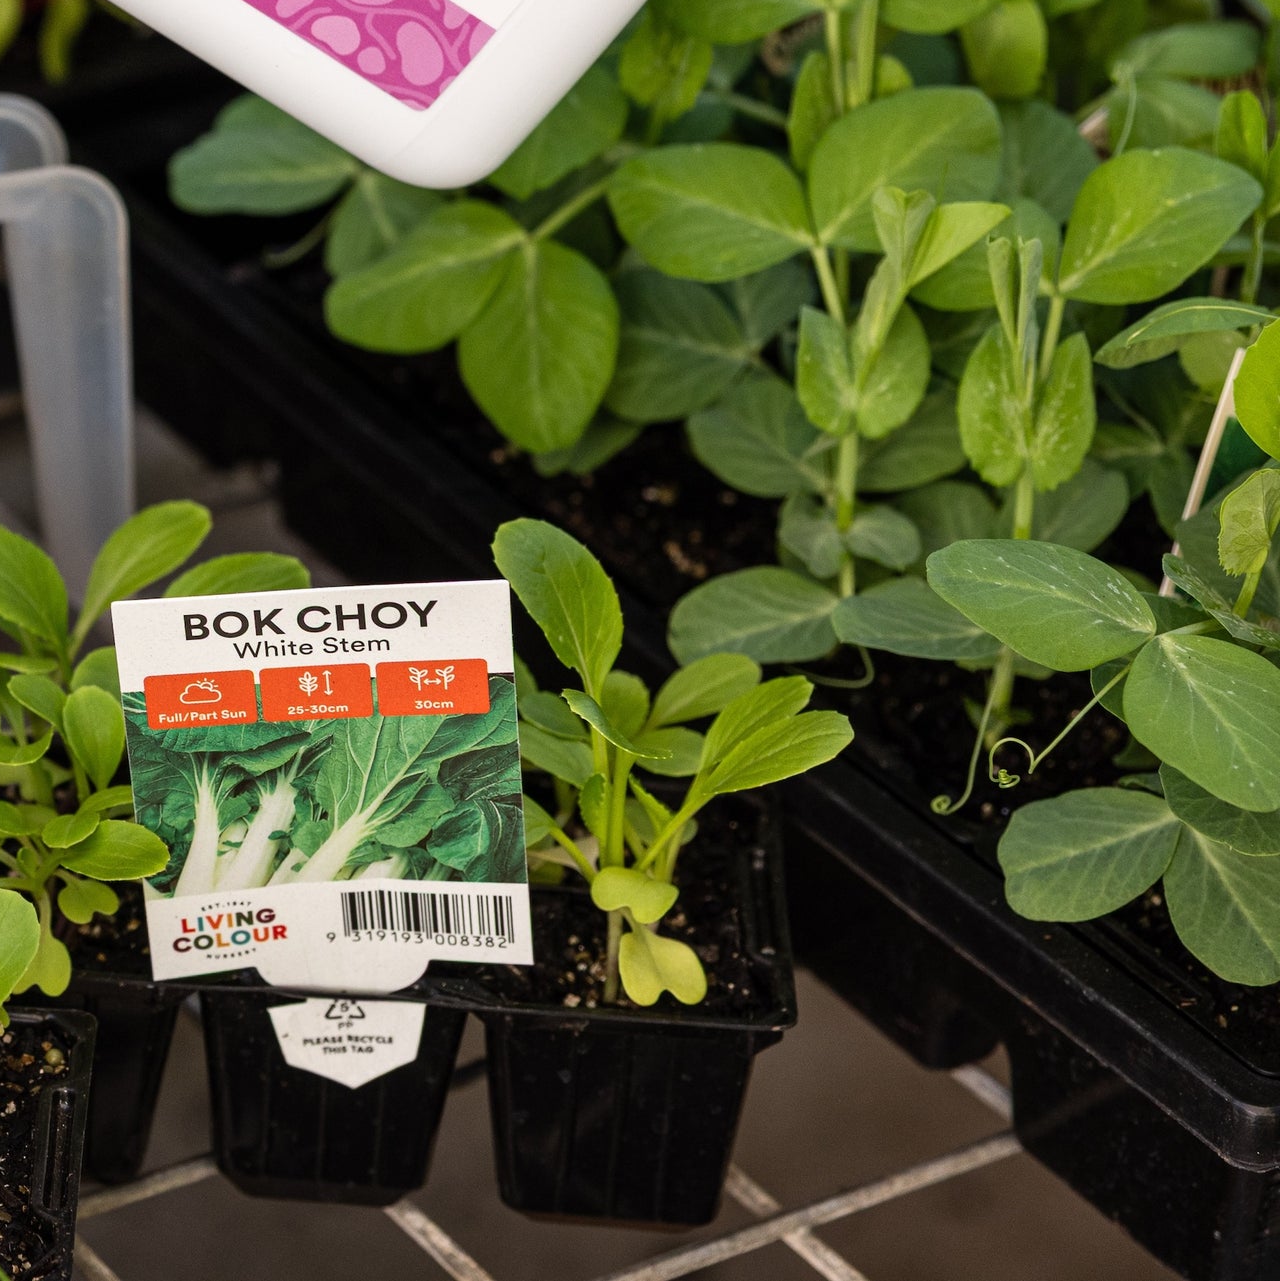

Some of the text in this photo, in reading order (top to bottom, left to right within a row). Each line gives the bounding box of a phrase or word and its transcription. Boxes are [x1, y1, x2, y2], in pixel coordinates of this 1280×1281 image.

[183, 600, 438, 641] BOK CHOY
[233, 636, 390, 659] White Stem
[287, 703, 349, 715] 25-30cm
[415, 699, 454, 711] 30cm
[158, 709, 246, 724] Full/Part Sun
[181, 908, 276, 933] LIVING
[173, 925, 287, 953] COLOUR
[352, 931, 424, 944] 319193
[435, 934, 507, 948] 008382
[303, 1034, 393, 1045] PLEASE RECYCLE
[323, 1045, 374, 1054] THIS TAG
